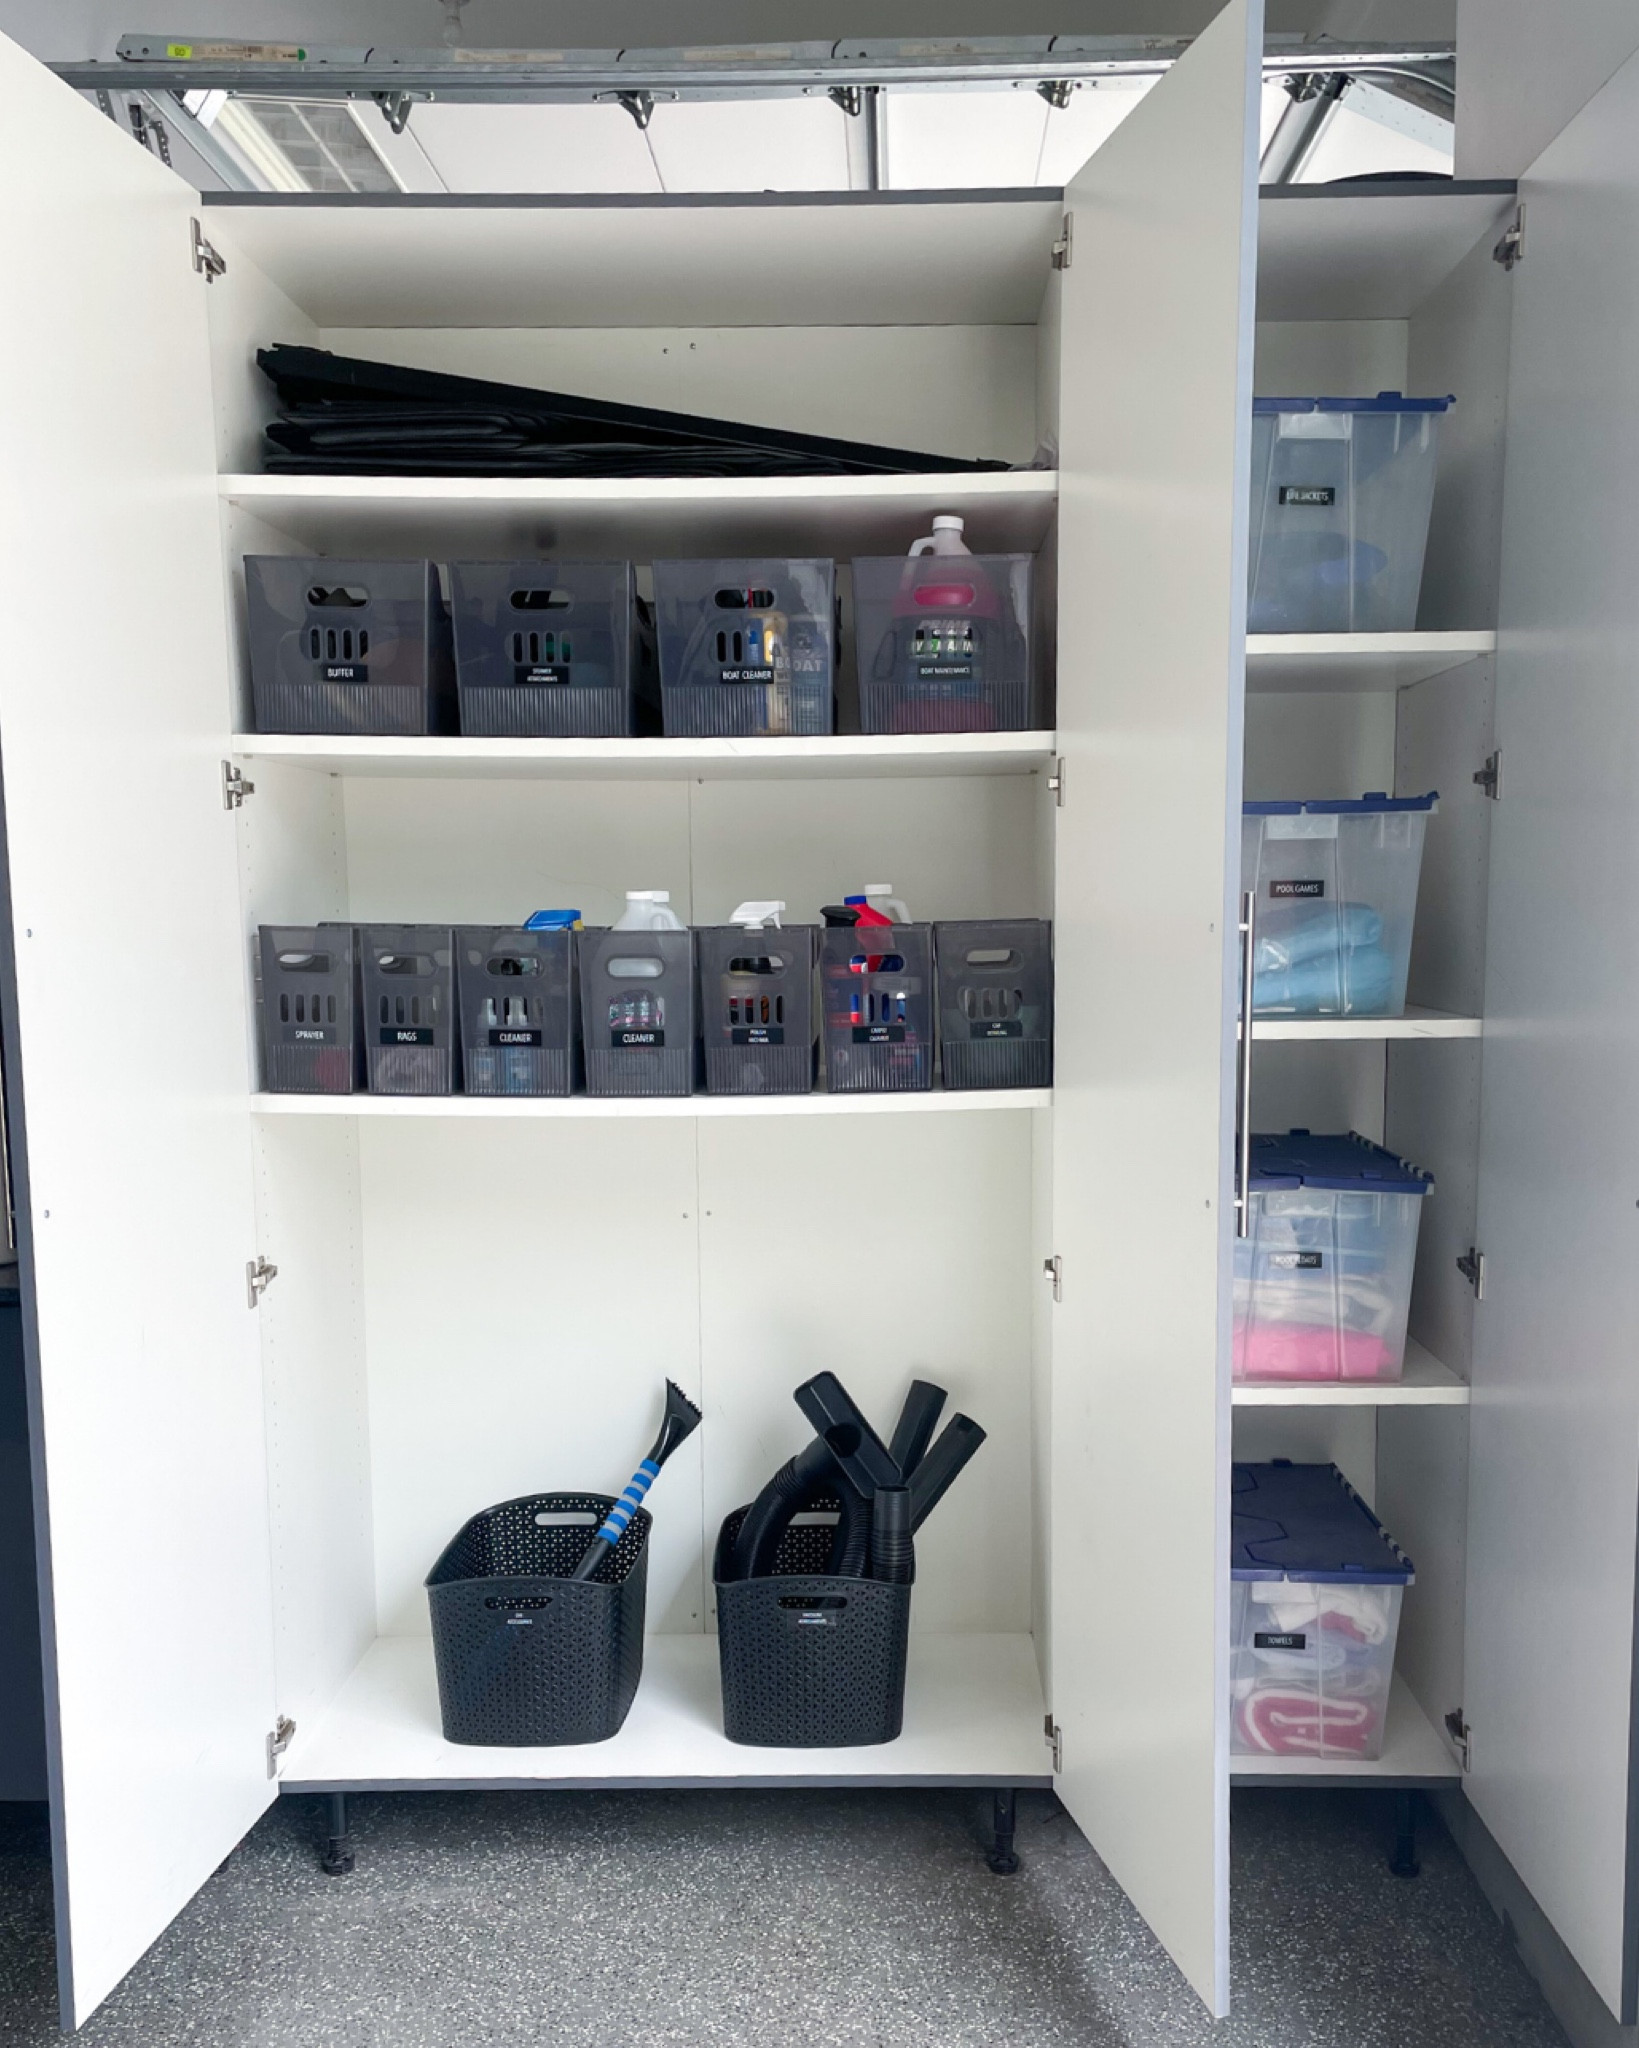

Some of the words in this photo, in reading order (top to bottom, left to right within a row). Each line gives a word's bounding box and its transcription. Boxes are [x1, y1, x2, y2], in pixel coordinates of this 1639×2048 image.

[327, 668, 354, 677] BUFFER
[722, 670, 740, 680] BOAT
[741, 670, 772, 680] CLEANER
[1275, 884, 1294, 893] POOL
[1294, 884, 1318, 893] GAMES
[397, 1031, 418, 1042] RAGS
[499, 1032, 533, 1043] CLEANER
[622, 1033, 655, 1043] CLEANER
[1267, 1636, 1293, 1646] TOWELS
